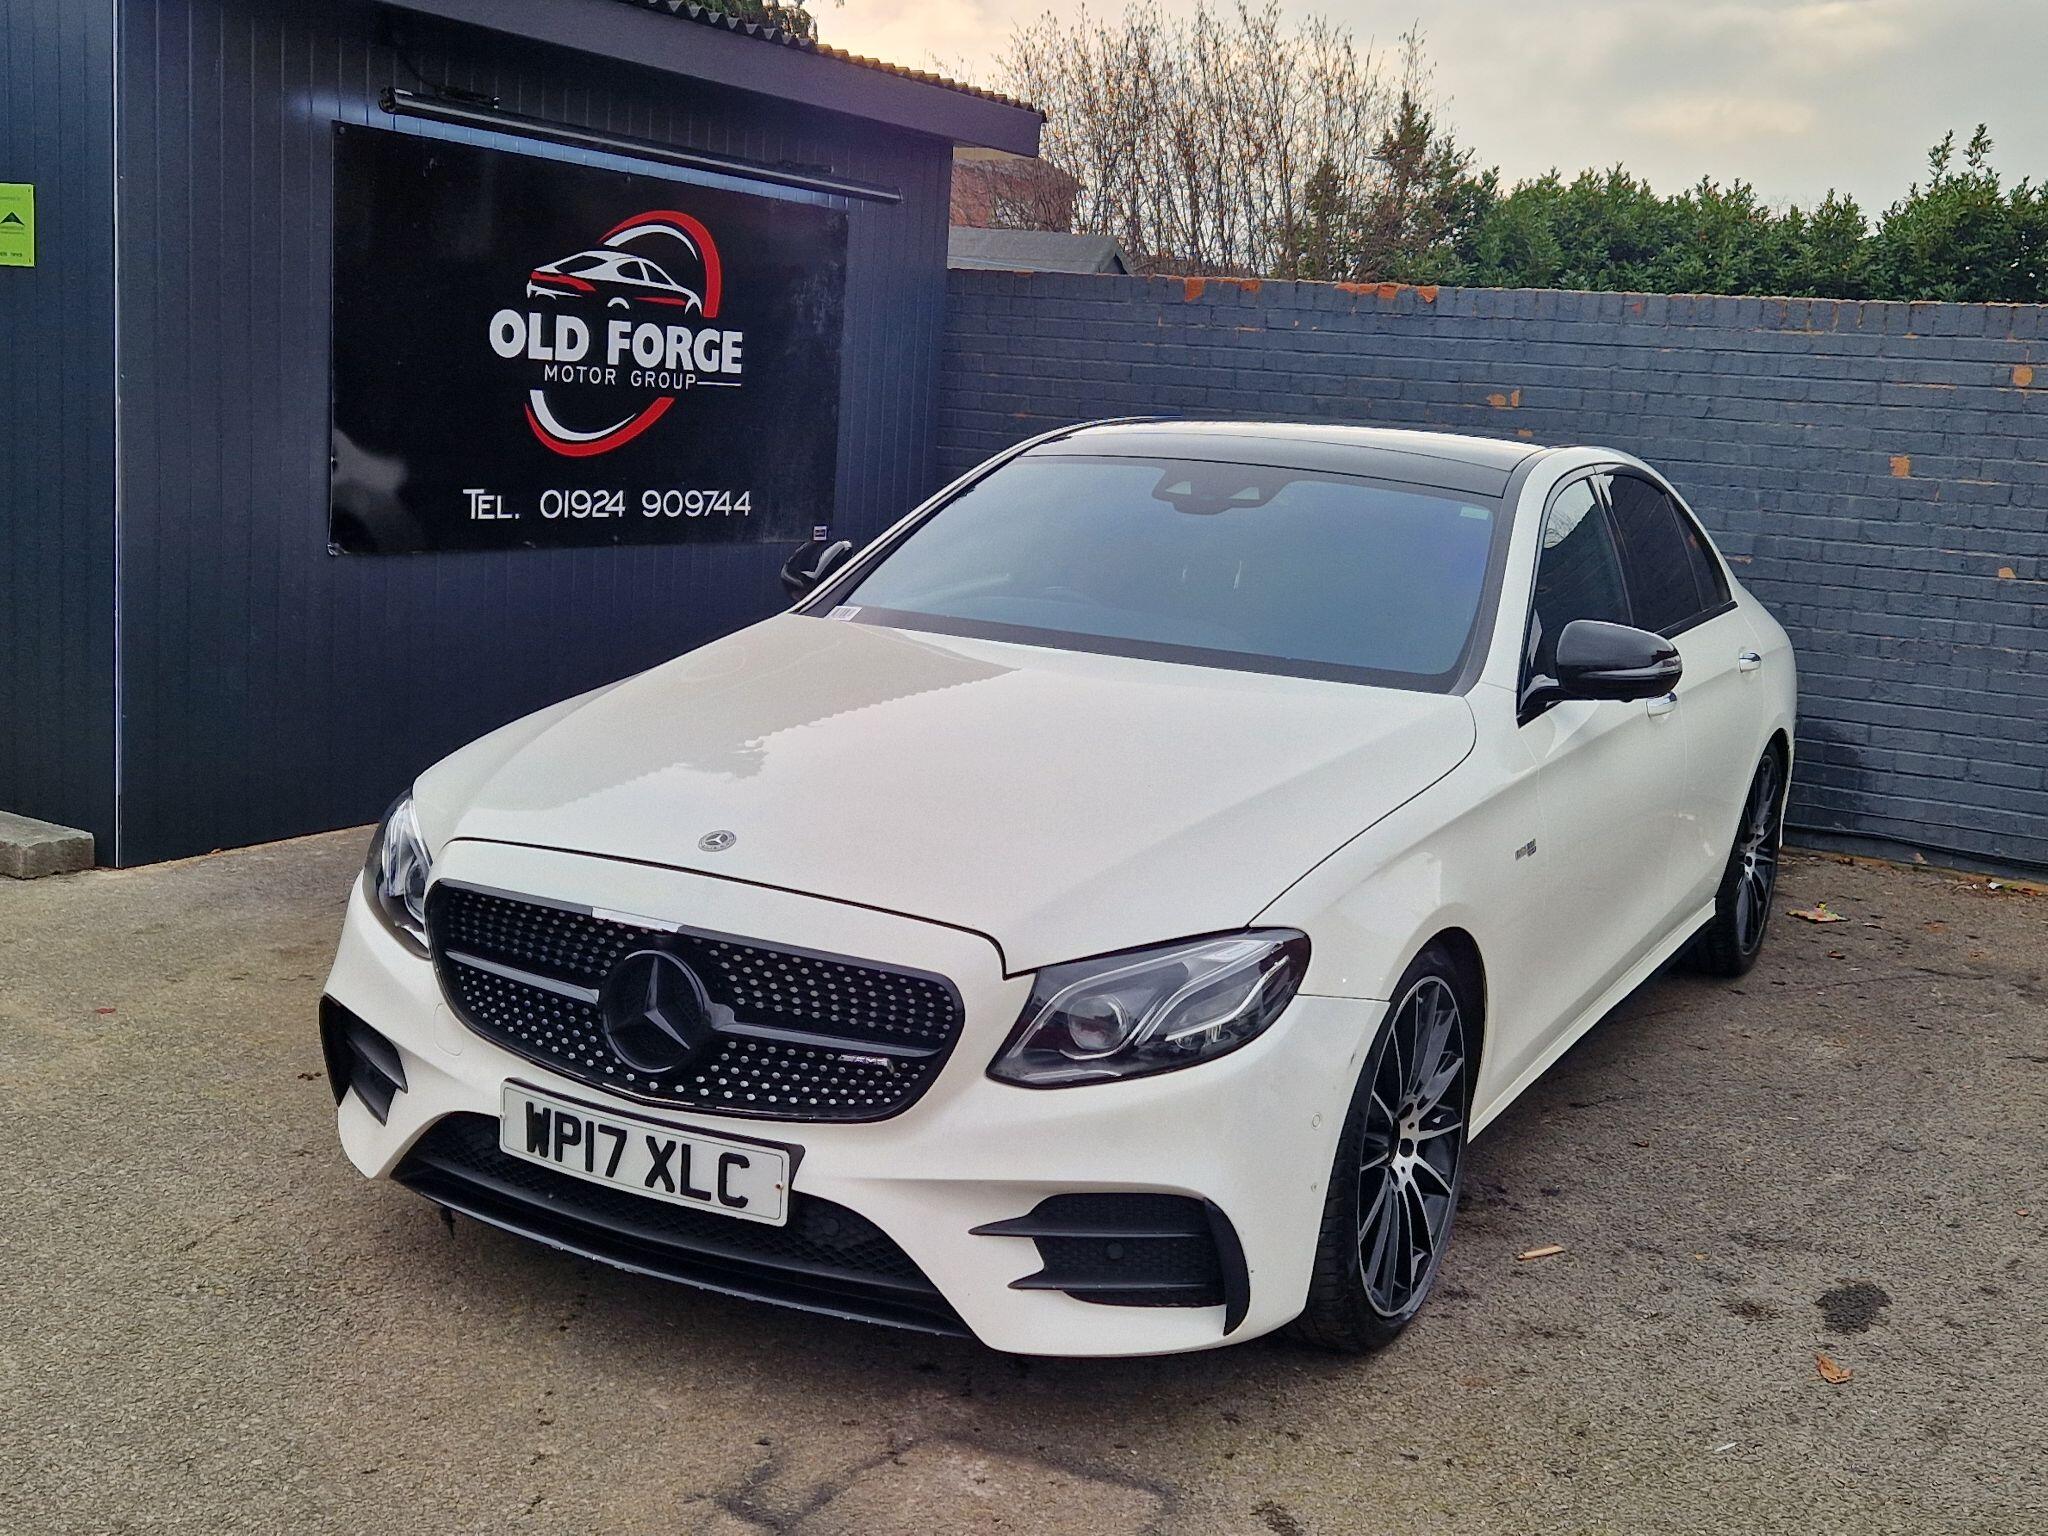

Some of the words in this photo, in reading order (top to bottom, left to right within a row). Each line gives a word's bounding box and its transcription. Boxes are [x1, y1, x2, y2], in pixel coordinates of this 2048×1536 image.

[489, 309, 588, 362] OLD
[608, 320, 743, 374] FORGE
[544, 364, 616, 386] MOTOR
[631, 370, 697, 390] GROUP
[463, 488, 520, 519] TEL.
[540, 489, 626, 518] 01924
[641, 490, 751, 517] 909744
[526, 1102, 627, 1178] WP17
[644, 1135, 750, 1208] XLC
